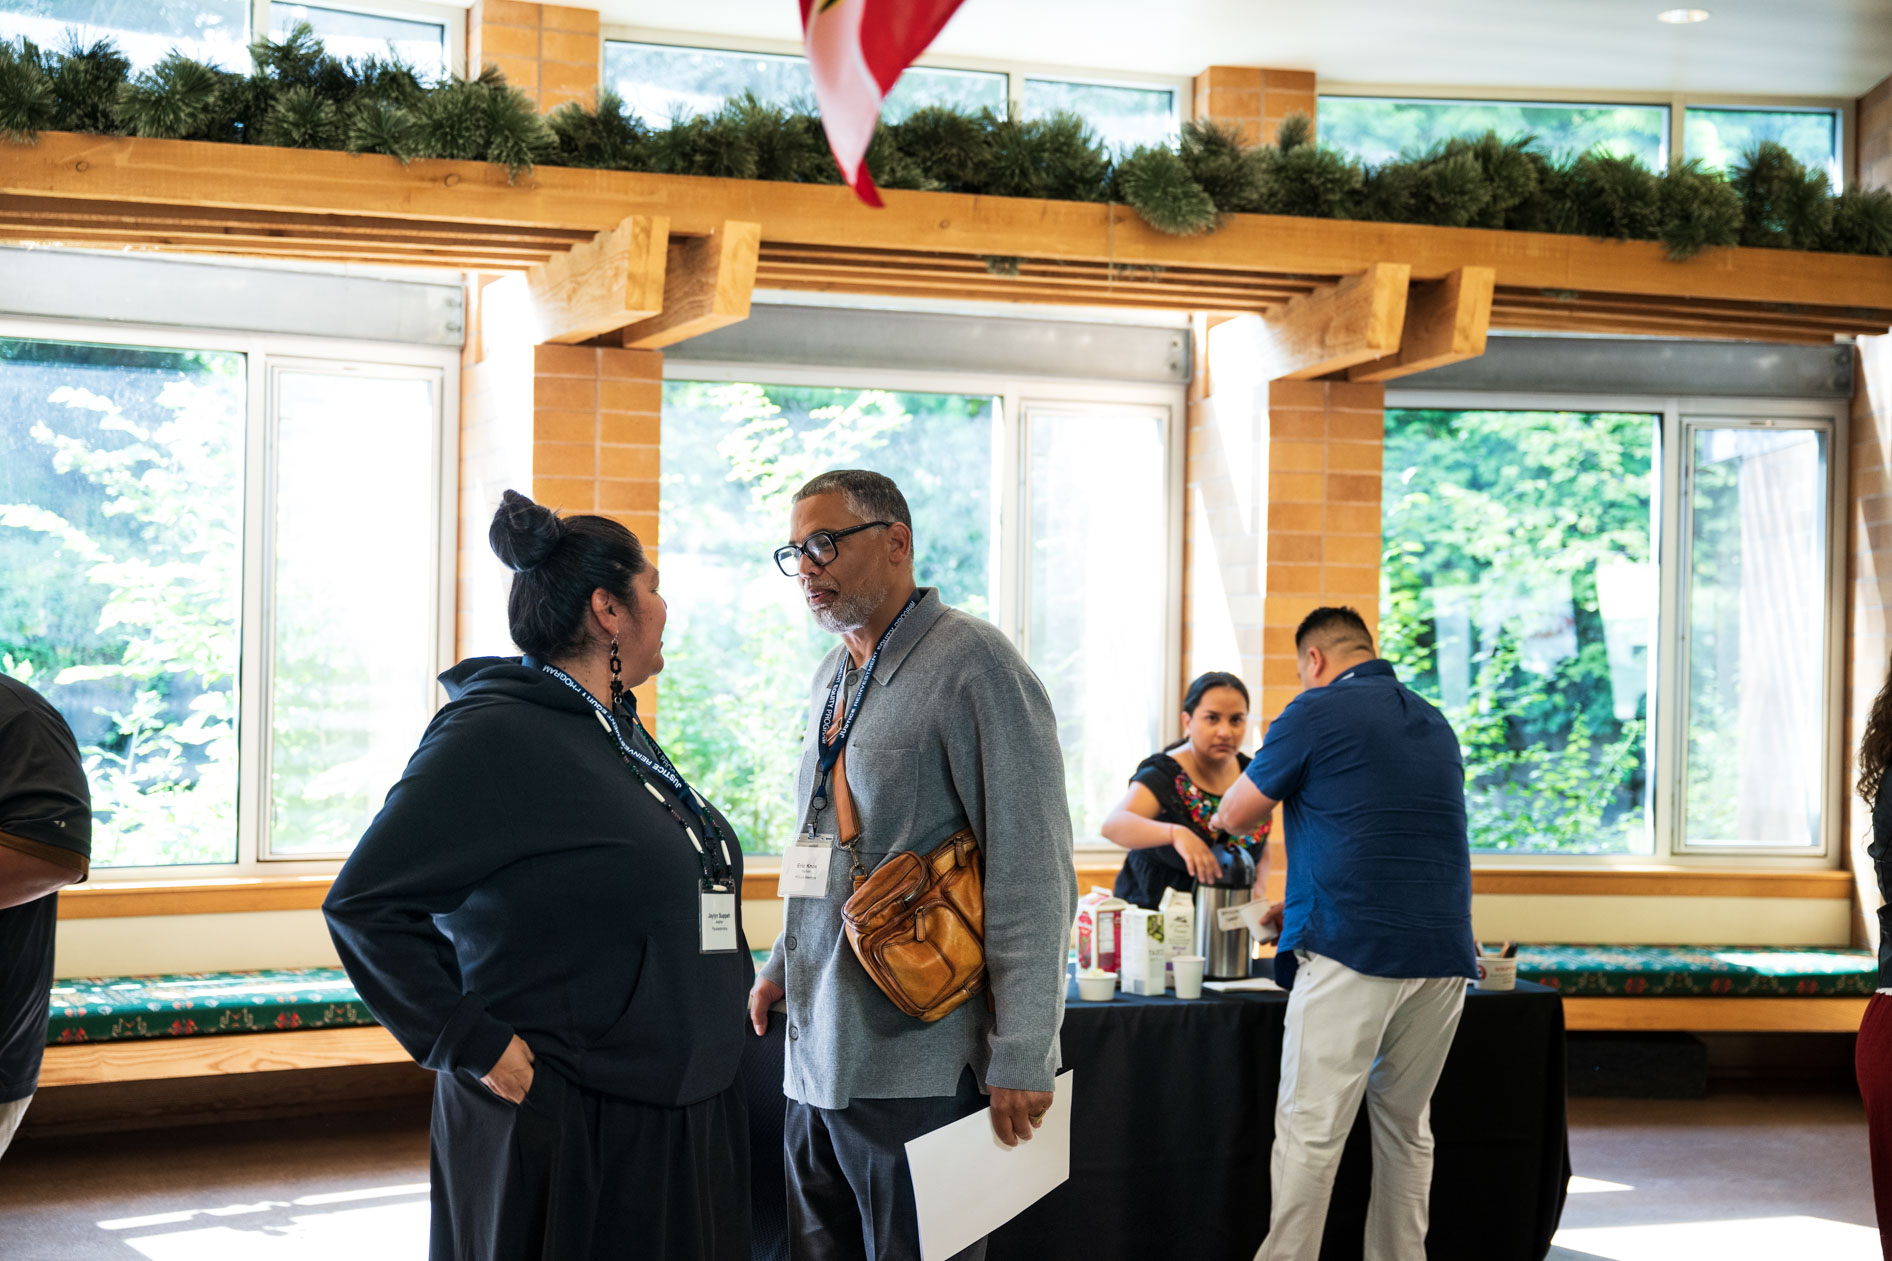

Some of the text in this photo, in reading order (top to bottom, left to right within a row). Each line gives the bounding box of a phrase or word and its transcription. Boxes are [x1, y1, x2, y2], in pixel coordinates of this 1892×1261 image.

[840, 709, 857, 739] JUSTICE
[853, 651, 878, 708] REINVESTMENT
[607, 712, 654, 766] REINVESTMENT
[651, 761, 682, 789] JUSTICE
